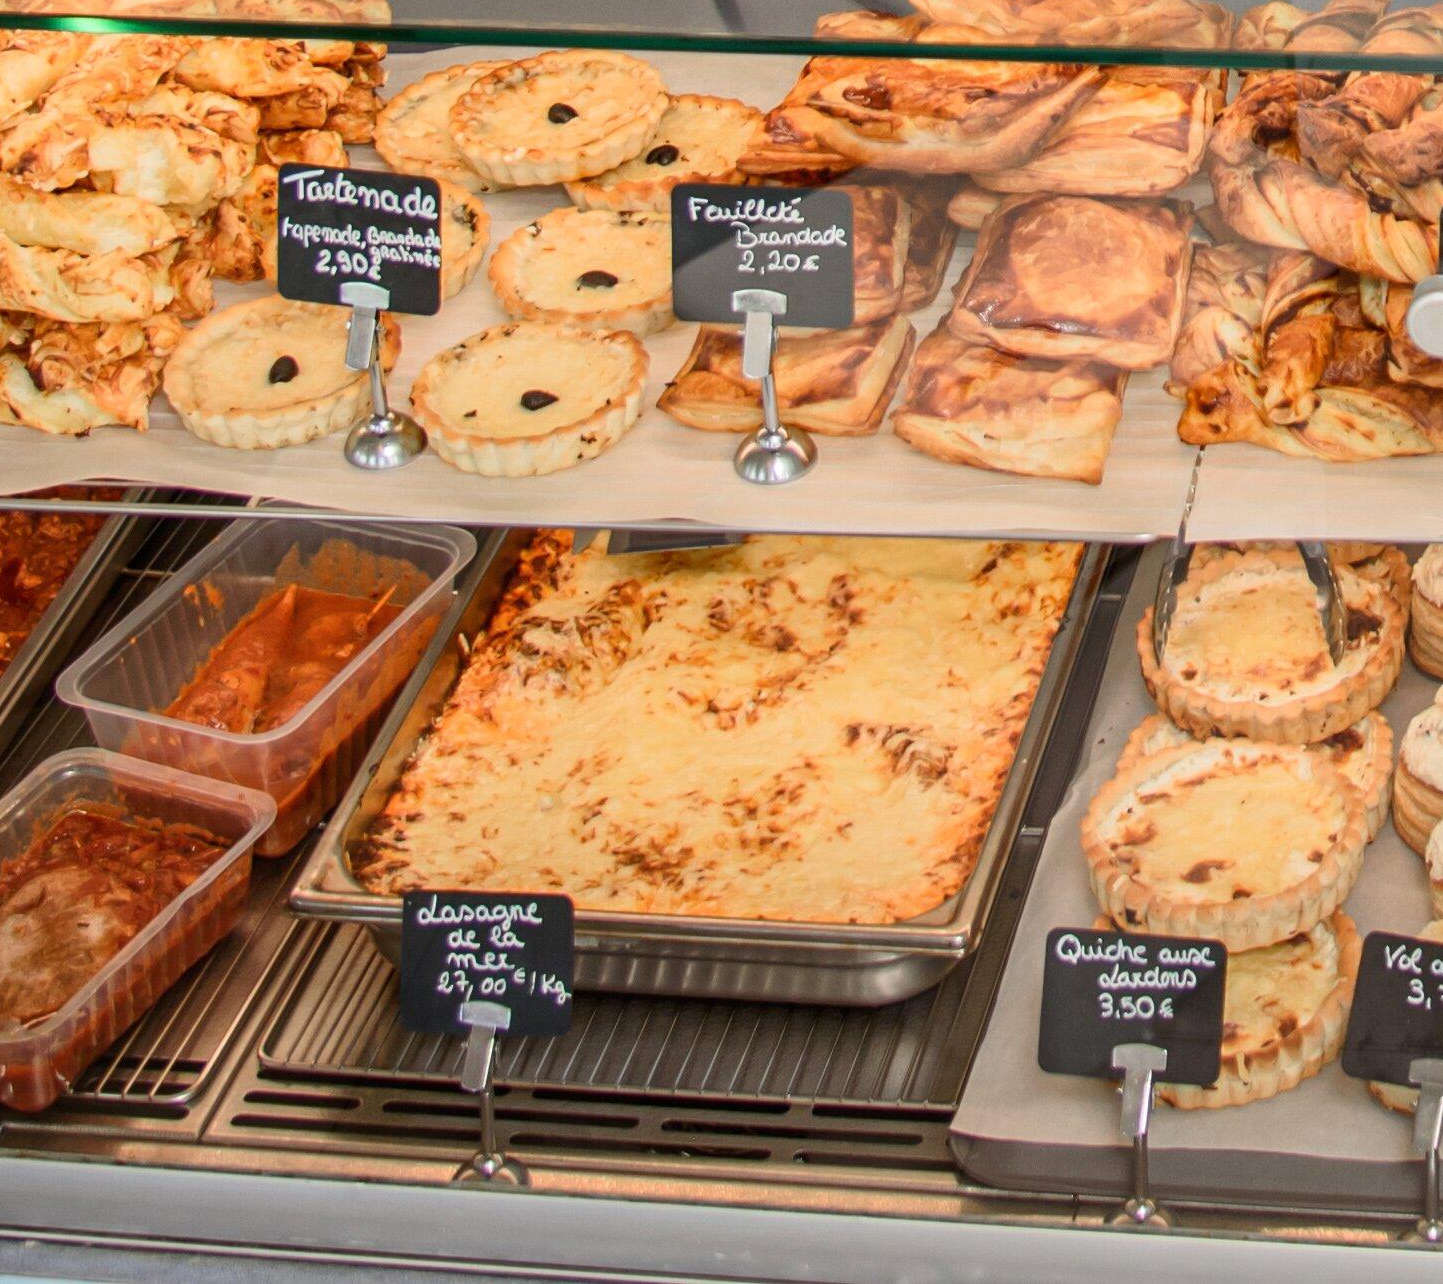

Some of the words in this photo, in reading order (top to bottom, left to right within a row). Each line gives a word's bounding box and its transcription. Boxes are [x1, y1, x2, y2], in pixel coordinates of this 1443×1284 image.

[284, 169, 439, 221] Tartenade
[687, 195, 806, 223] Feuilleté
[731, 220, 849, 249] Brandade
[416, 893, 543, 931] Lasagne
[447, 928, 481, 949] de
[489, 924, 526, 950] la
[1056, 933, 1149, 966] Quiche
[446, 951, 516, 970] mer
[1383, 944, 1424, 975] Vol
